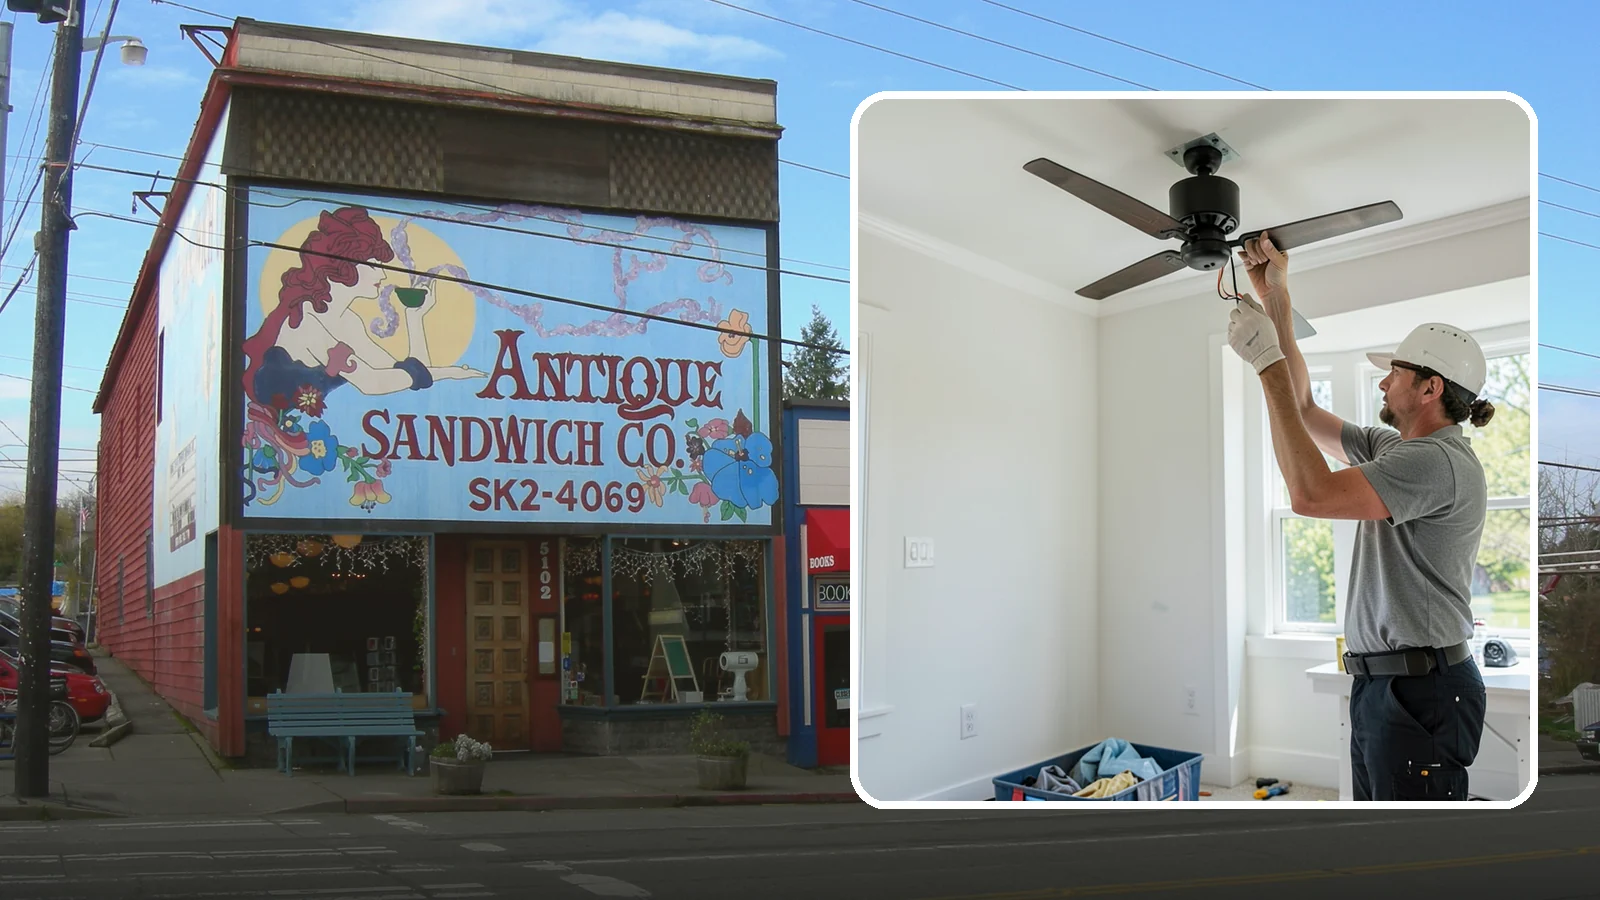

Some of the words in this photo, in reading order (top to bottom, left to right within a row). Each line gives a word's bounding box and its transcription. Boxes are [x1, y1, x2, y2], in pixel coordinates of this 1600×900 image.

[476, 329, 723, 420] ANTIQUE
[361, 408, 604, 467] SANDWICH
[617, 421, 685, 469] CO.
[468, 477, 645, 513] SK2-4069
[540, 542, 551, 599] 5102
[809, 555, 834, 569] BOOKS
